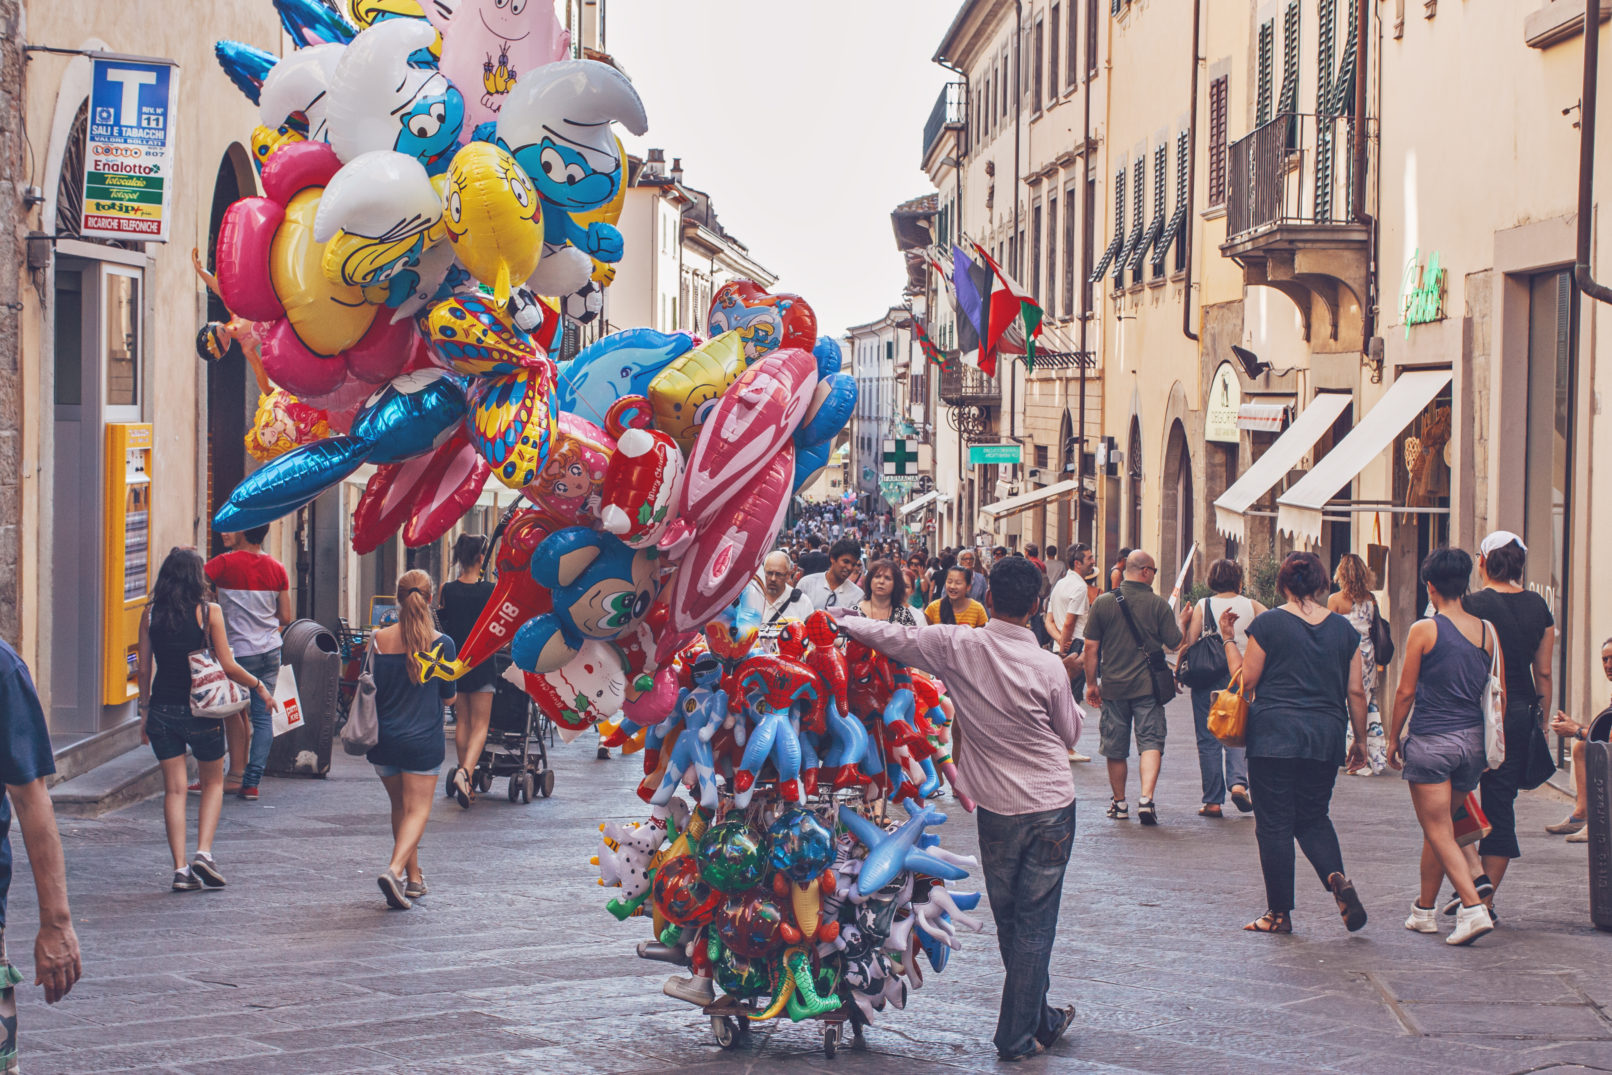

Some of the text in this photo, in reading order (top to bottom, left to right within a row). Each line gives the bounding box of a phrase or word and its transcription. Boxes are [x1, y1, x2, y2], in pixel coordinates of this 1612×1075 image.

[107, 68, 156, 126] T
[144, 116, 160, 127] 11
[92, 125, 164, 139] SALI E TABACCHI
[127, 138, 161, 146] BOLLATI
[94, 160, 152, 175] Enalotto
[104, 174, 146, 187] Totocalcio
[109, 188, 139, 202] Totogol
[87, 217, 159, 233] RICARICHE TELEFONICHE
[647, 446, 665, 500] Merry Christmas
[489, 601, 519, 637] 8-18
